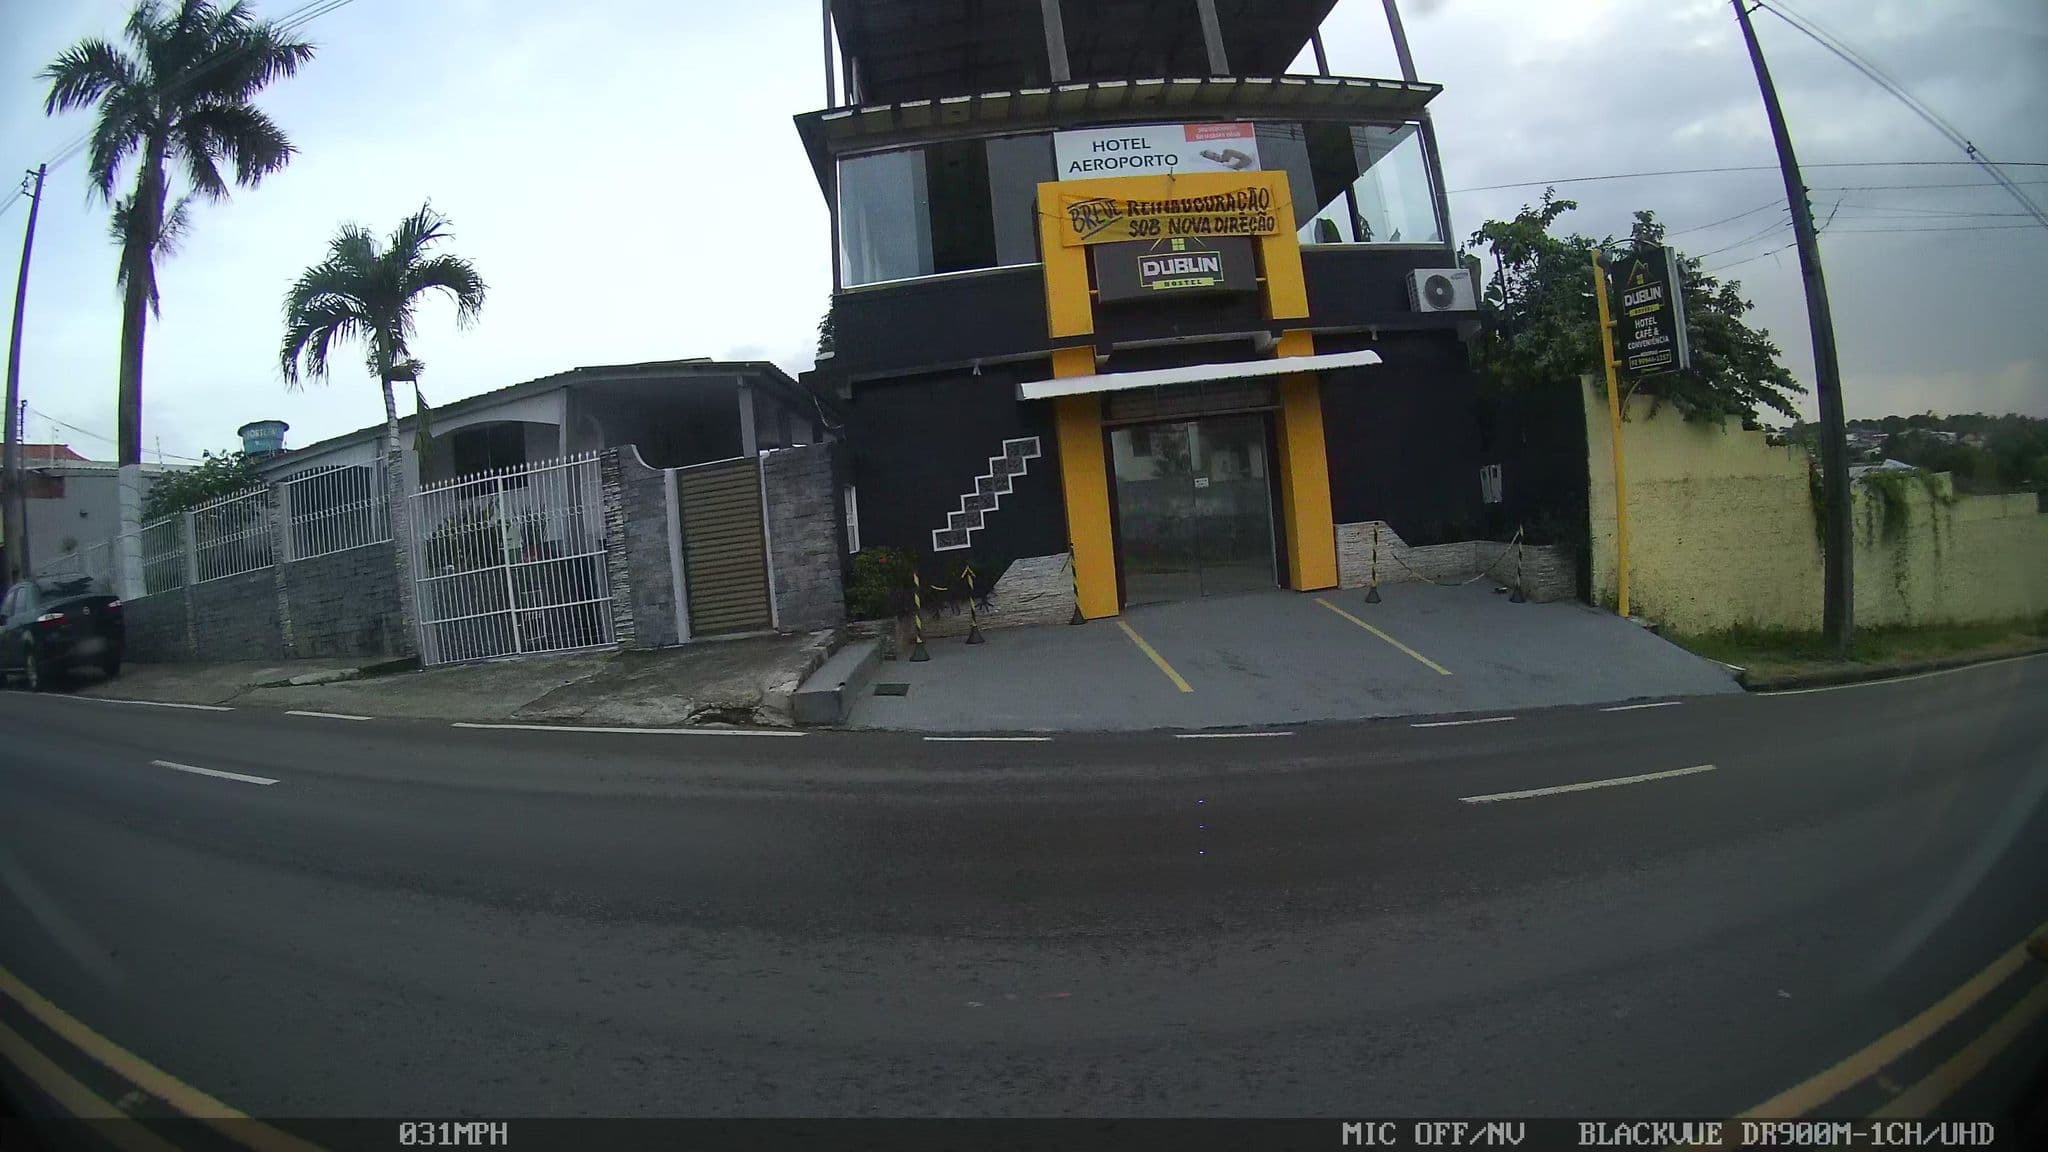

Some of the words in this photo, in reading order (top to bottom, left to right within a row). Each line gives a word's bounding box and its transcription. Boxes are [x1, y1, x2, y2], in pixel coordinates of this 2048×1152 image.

[1092, 138, 1151, 152] HOTEL
[1069, 154, 1179, 173] AEROPORTO
[1128, 218, 1161, 238] SOB
[1168, 217, 1211, 235] NOVA
[1143, 256, 1219, 277] DUBLIN
[1625, 286, 1662, 306] DUBLIN
[1634, 316, 1658, 329] HOTEL
[1634, 327, 1653, 340] CAFÉ
